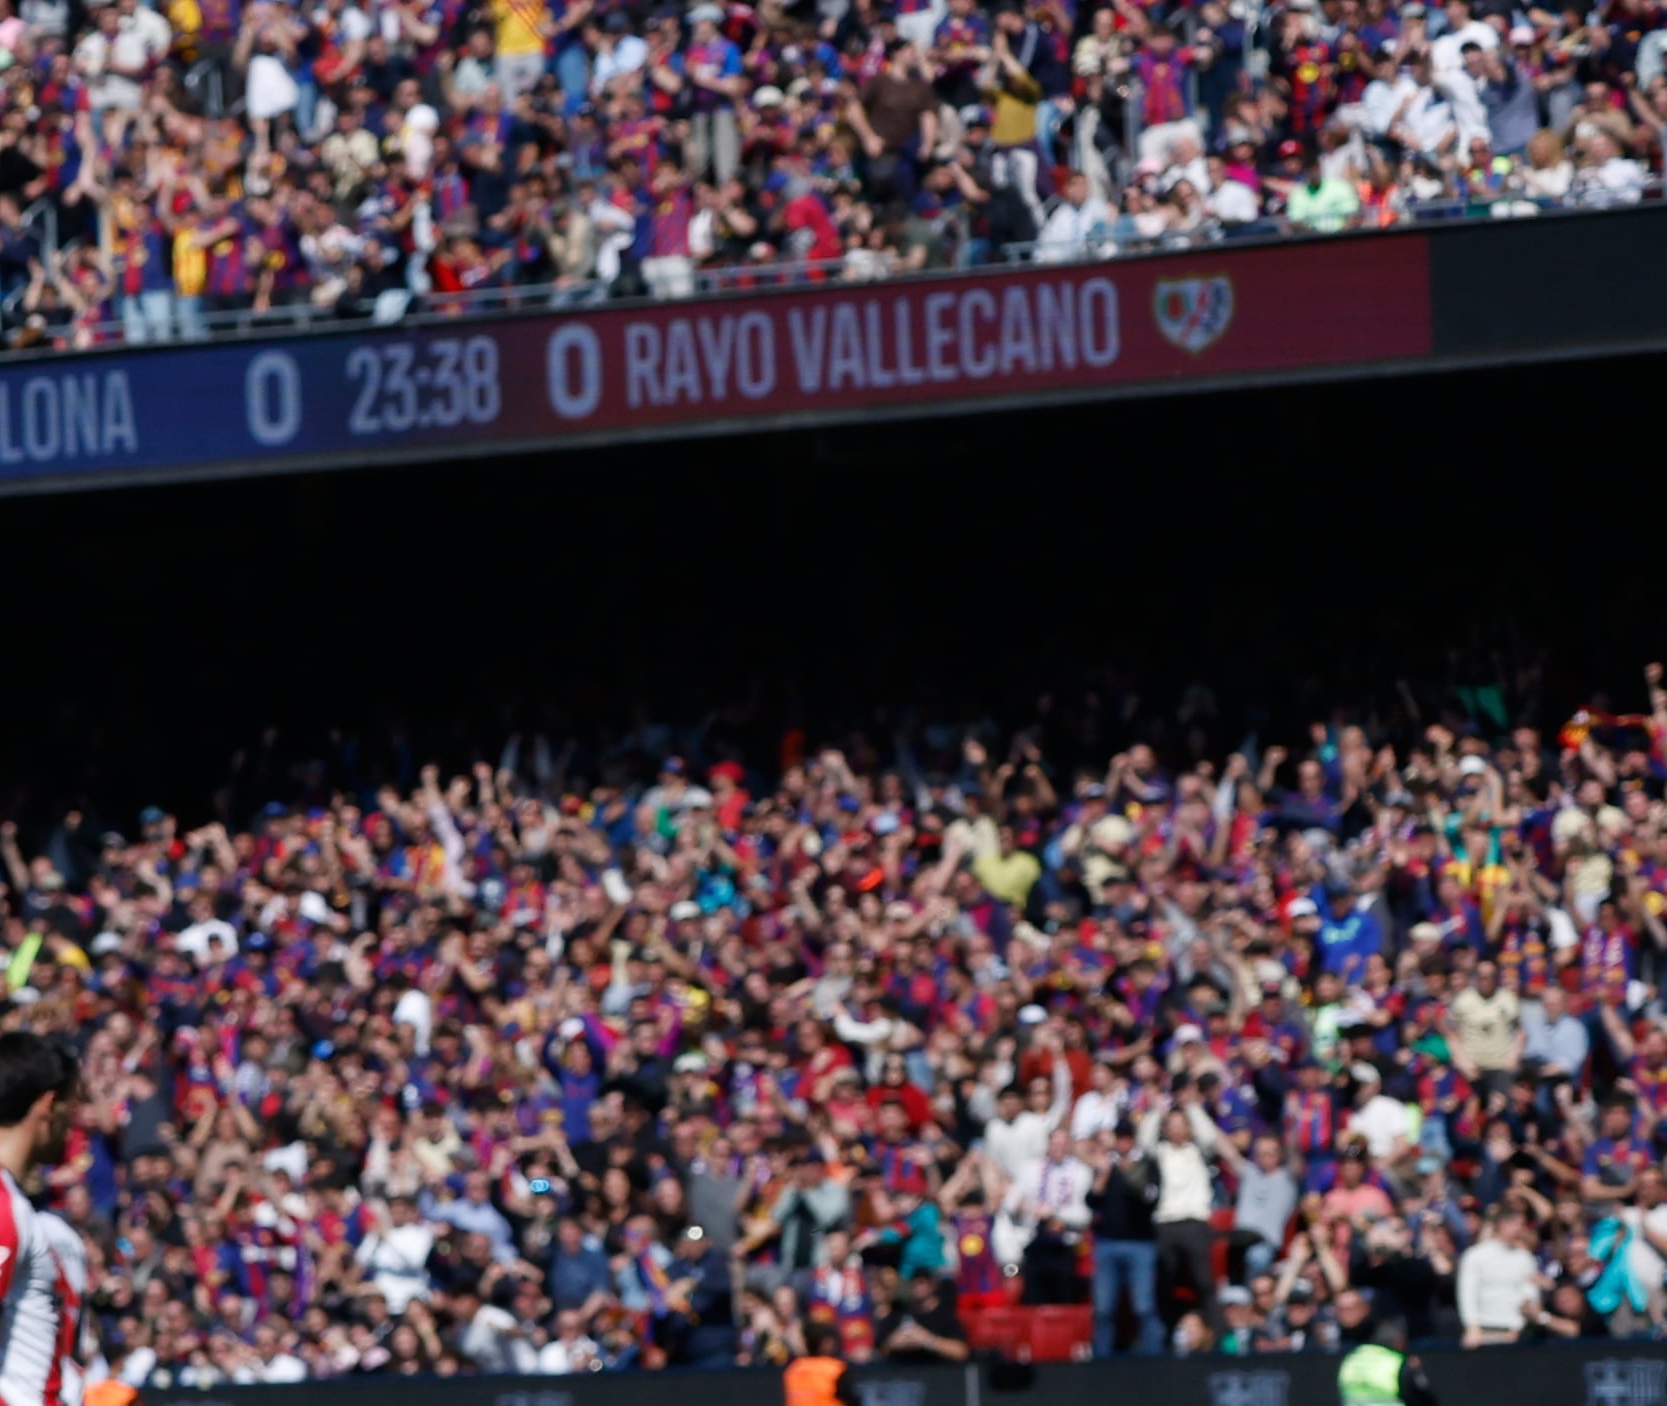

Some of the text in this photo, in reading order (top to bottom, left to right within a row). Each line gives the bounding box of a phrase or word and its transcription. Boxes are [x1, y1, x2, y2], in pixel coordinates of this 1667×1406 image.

[346, 335, 502, 435] 23:38
[547, 322, 602, 419] 0
[624, 277, 1121, 407] RAYO VALLECANO
[245, 351, 300, 445] 0
